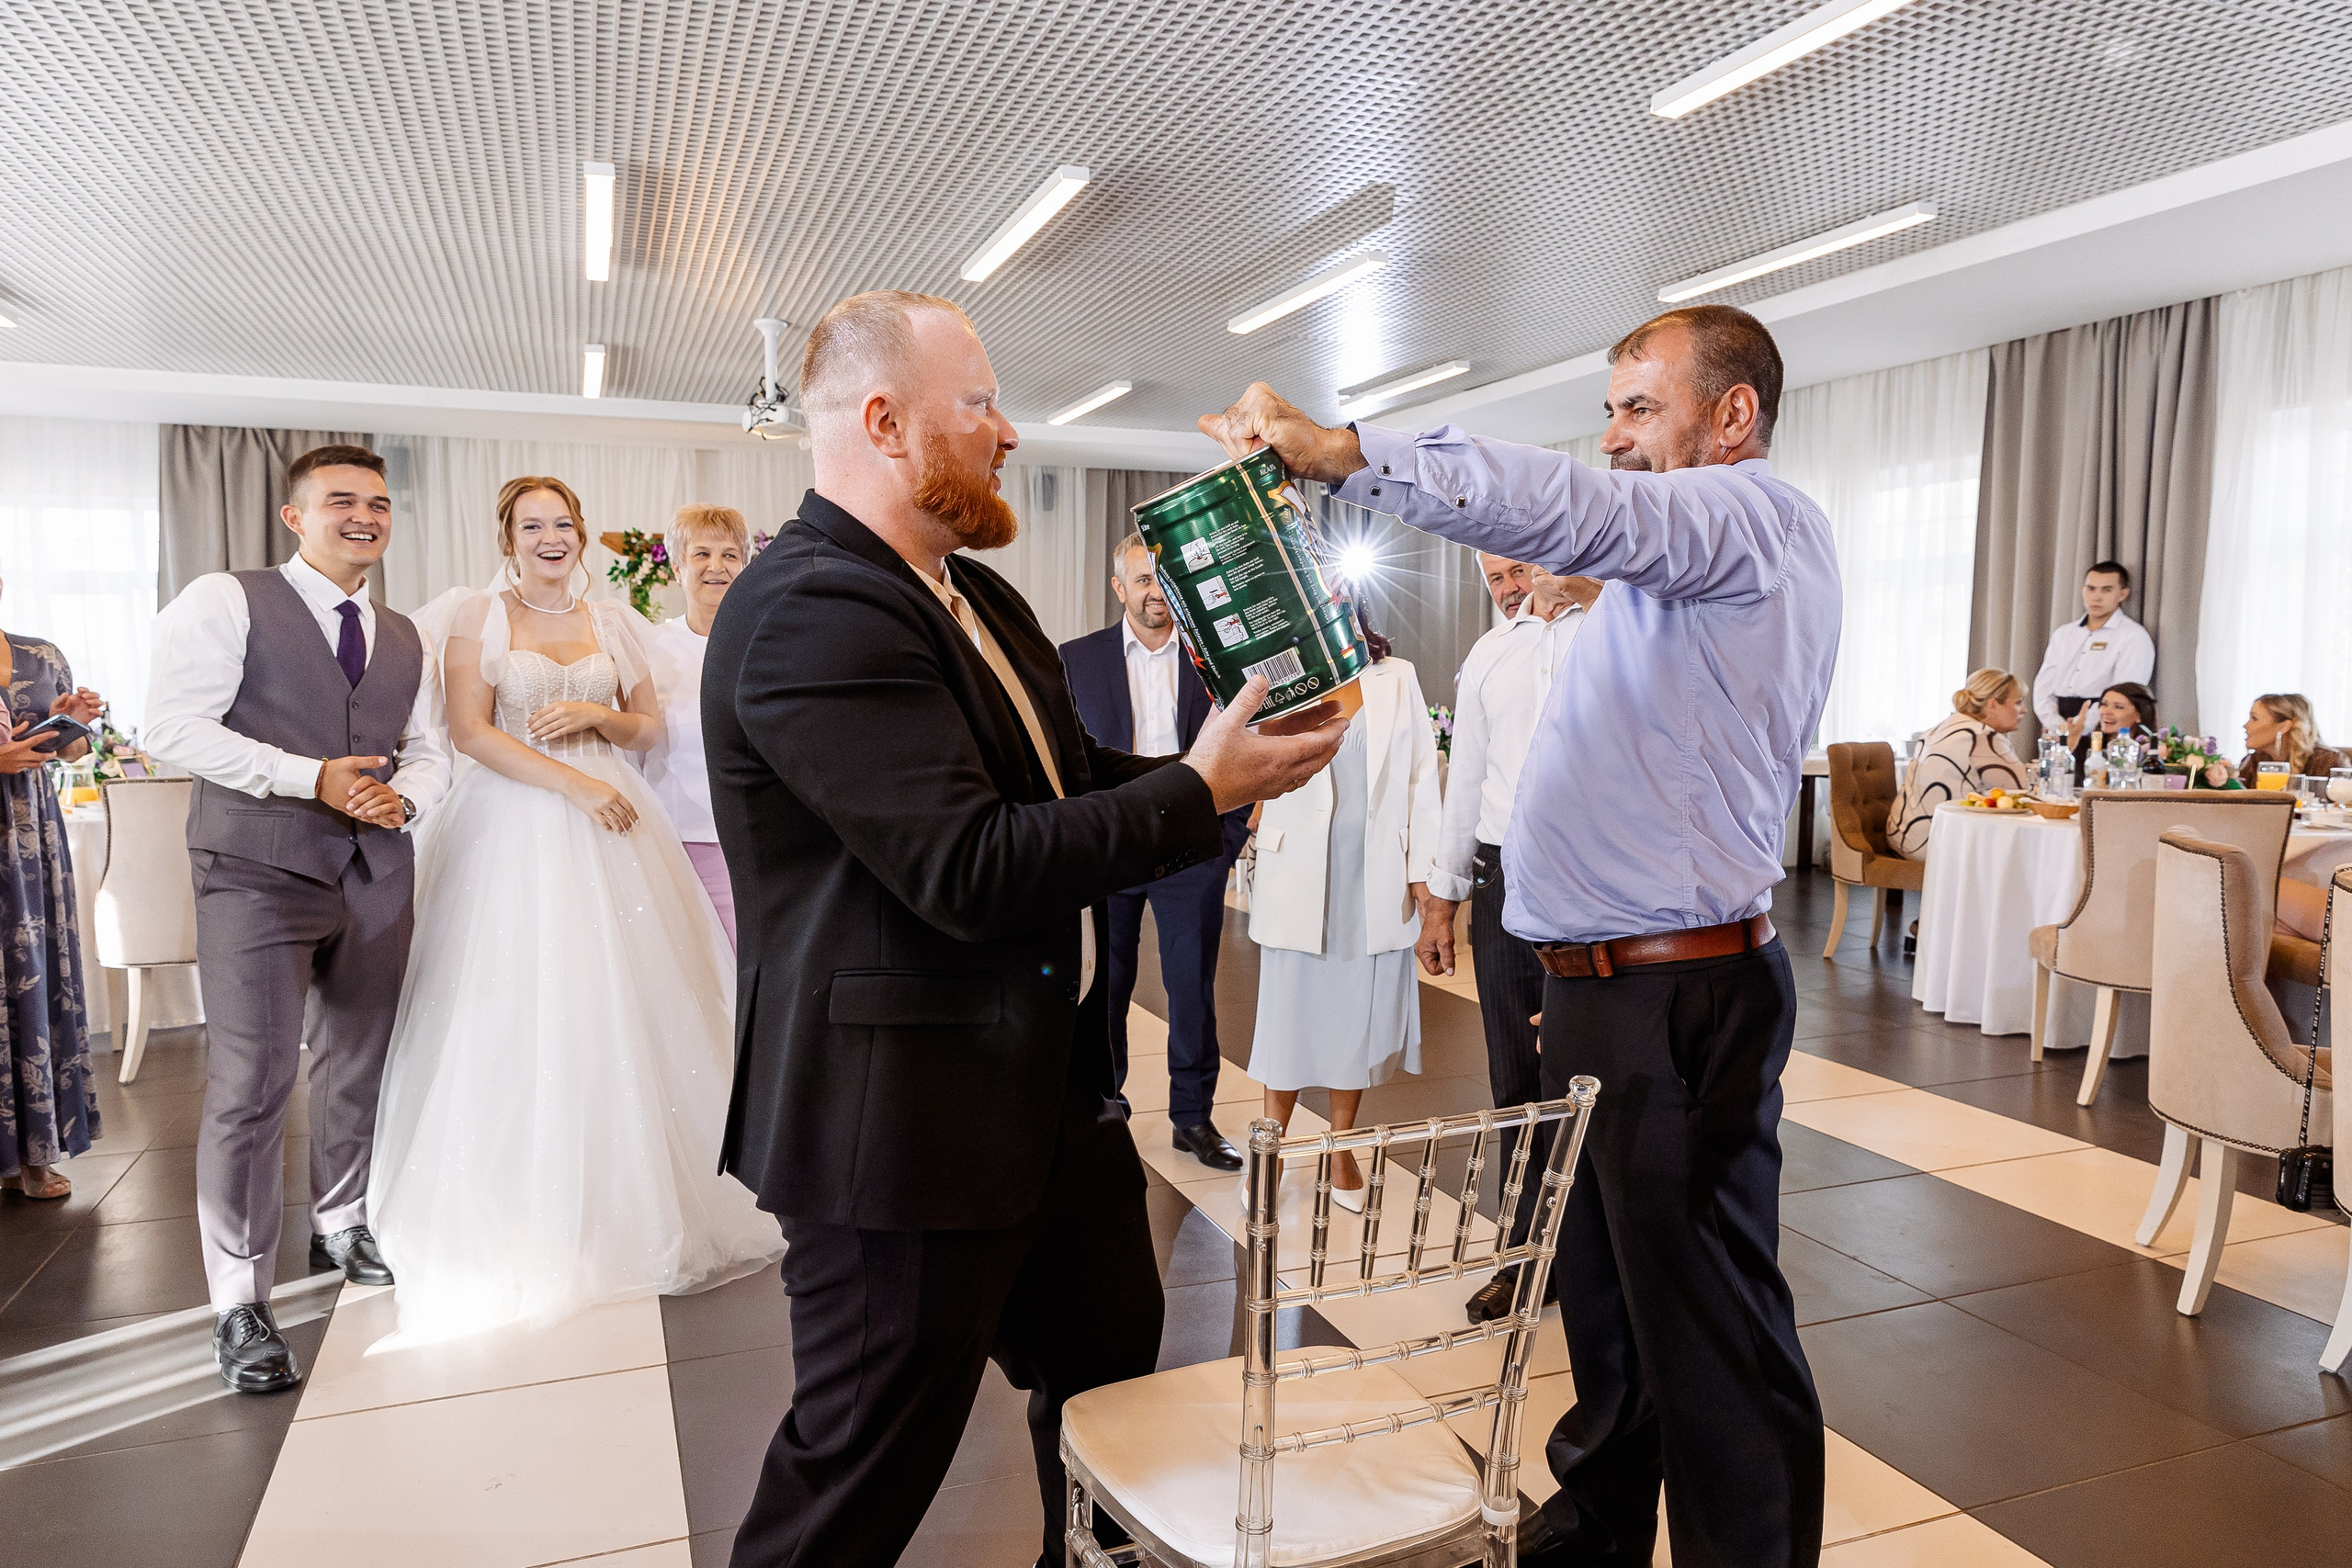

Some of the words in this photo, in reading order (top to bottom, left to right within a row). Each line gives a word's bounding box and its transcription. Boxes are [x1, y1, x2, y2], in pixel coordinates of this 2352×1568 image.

[2302, 1089, 2311, 1128] BETTER
[2308, 1031, 2317, 1078] FOREVER
[2313, 987, 2322, 1027] BETTER
[2319, 928, 2328, 976] FOREVER
[2324, 884, 2334, 924] BETTER
